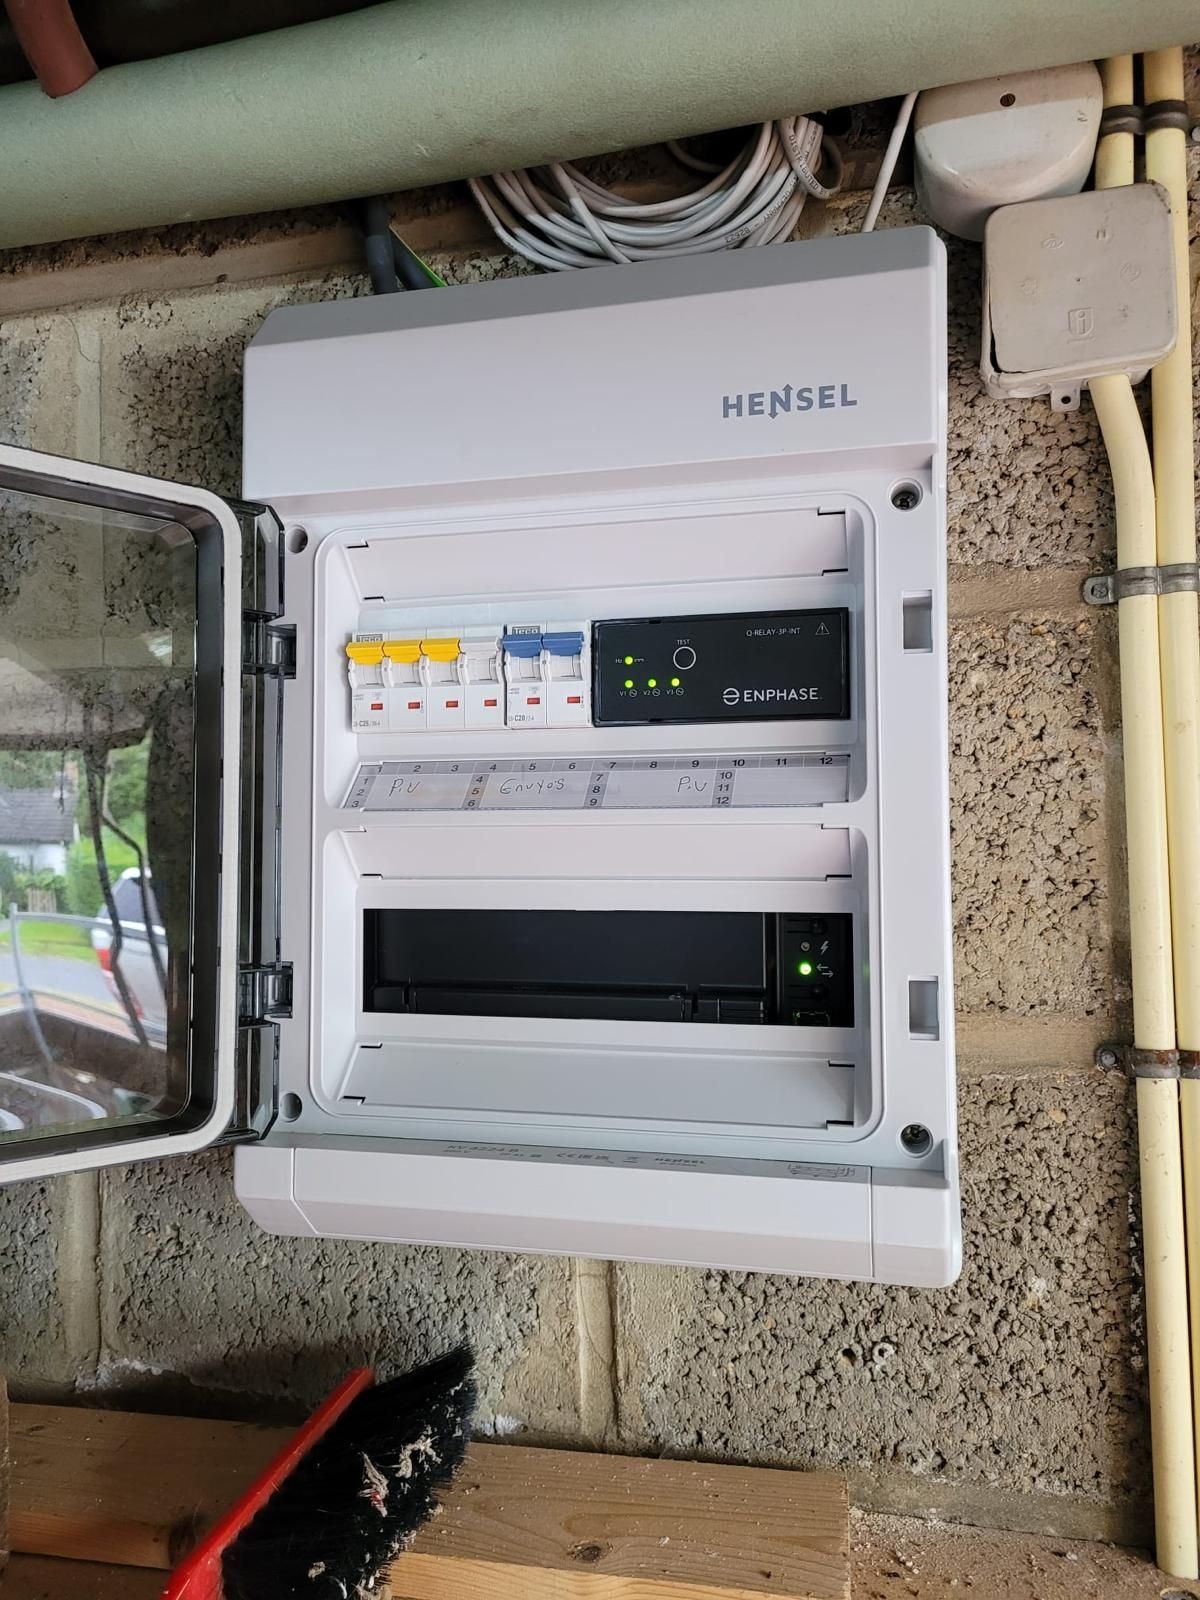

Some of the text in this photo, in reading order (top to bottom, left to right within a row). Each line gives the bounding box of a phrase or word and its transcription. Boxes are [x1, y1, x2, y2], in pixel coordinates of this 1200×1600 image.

[788, 134, 819, 190] DISTRIBUTED
[722, 384, 857, 419] HENSEL
[746, 627, 801, 637] Q-RELAY-3P-INT
[743, 687, 819, 703] ENPHASE
[412, 764, 422, 773] 2
[450, 764, 459, 772] 3
[489, 763, 497, 771] 4
[568, 762, 576, 770] 6
[609, 761, 617, 769] 7
[691, 760, 700, 768] 9
[732, 759, 745, 767] 10
[819, 757, 833, 765] 12
[595, 773, 604, 782] 7
[351, 800, 360, 808] 3
[467, 799, 476, 807] 6
[590, 798, 598, 806] 9
[715, 796, 729, 804] 12
